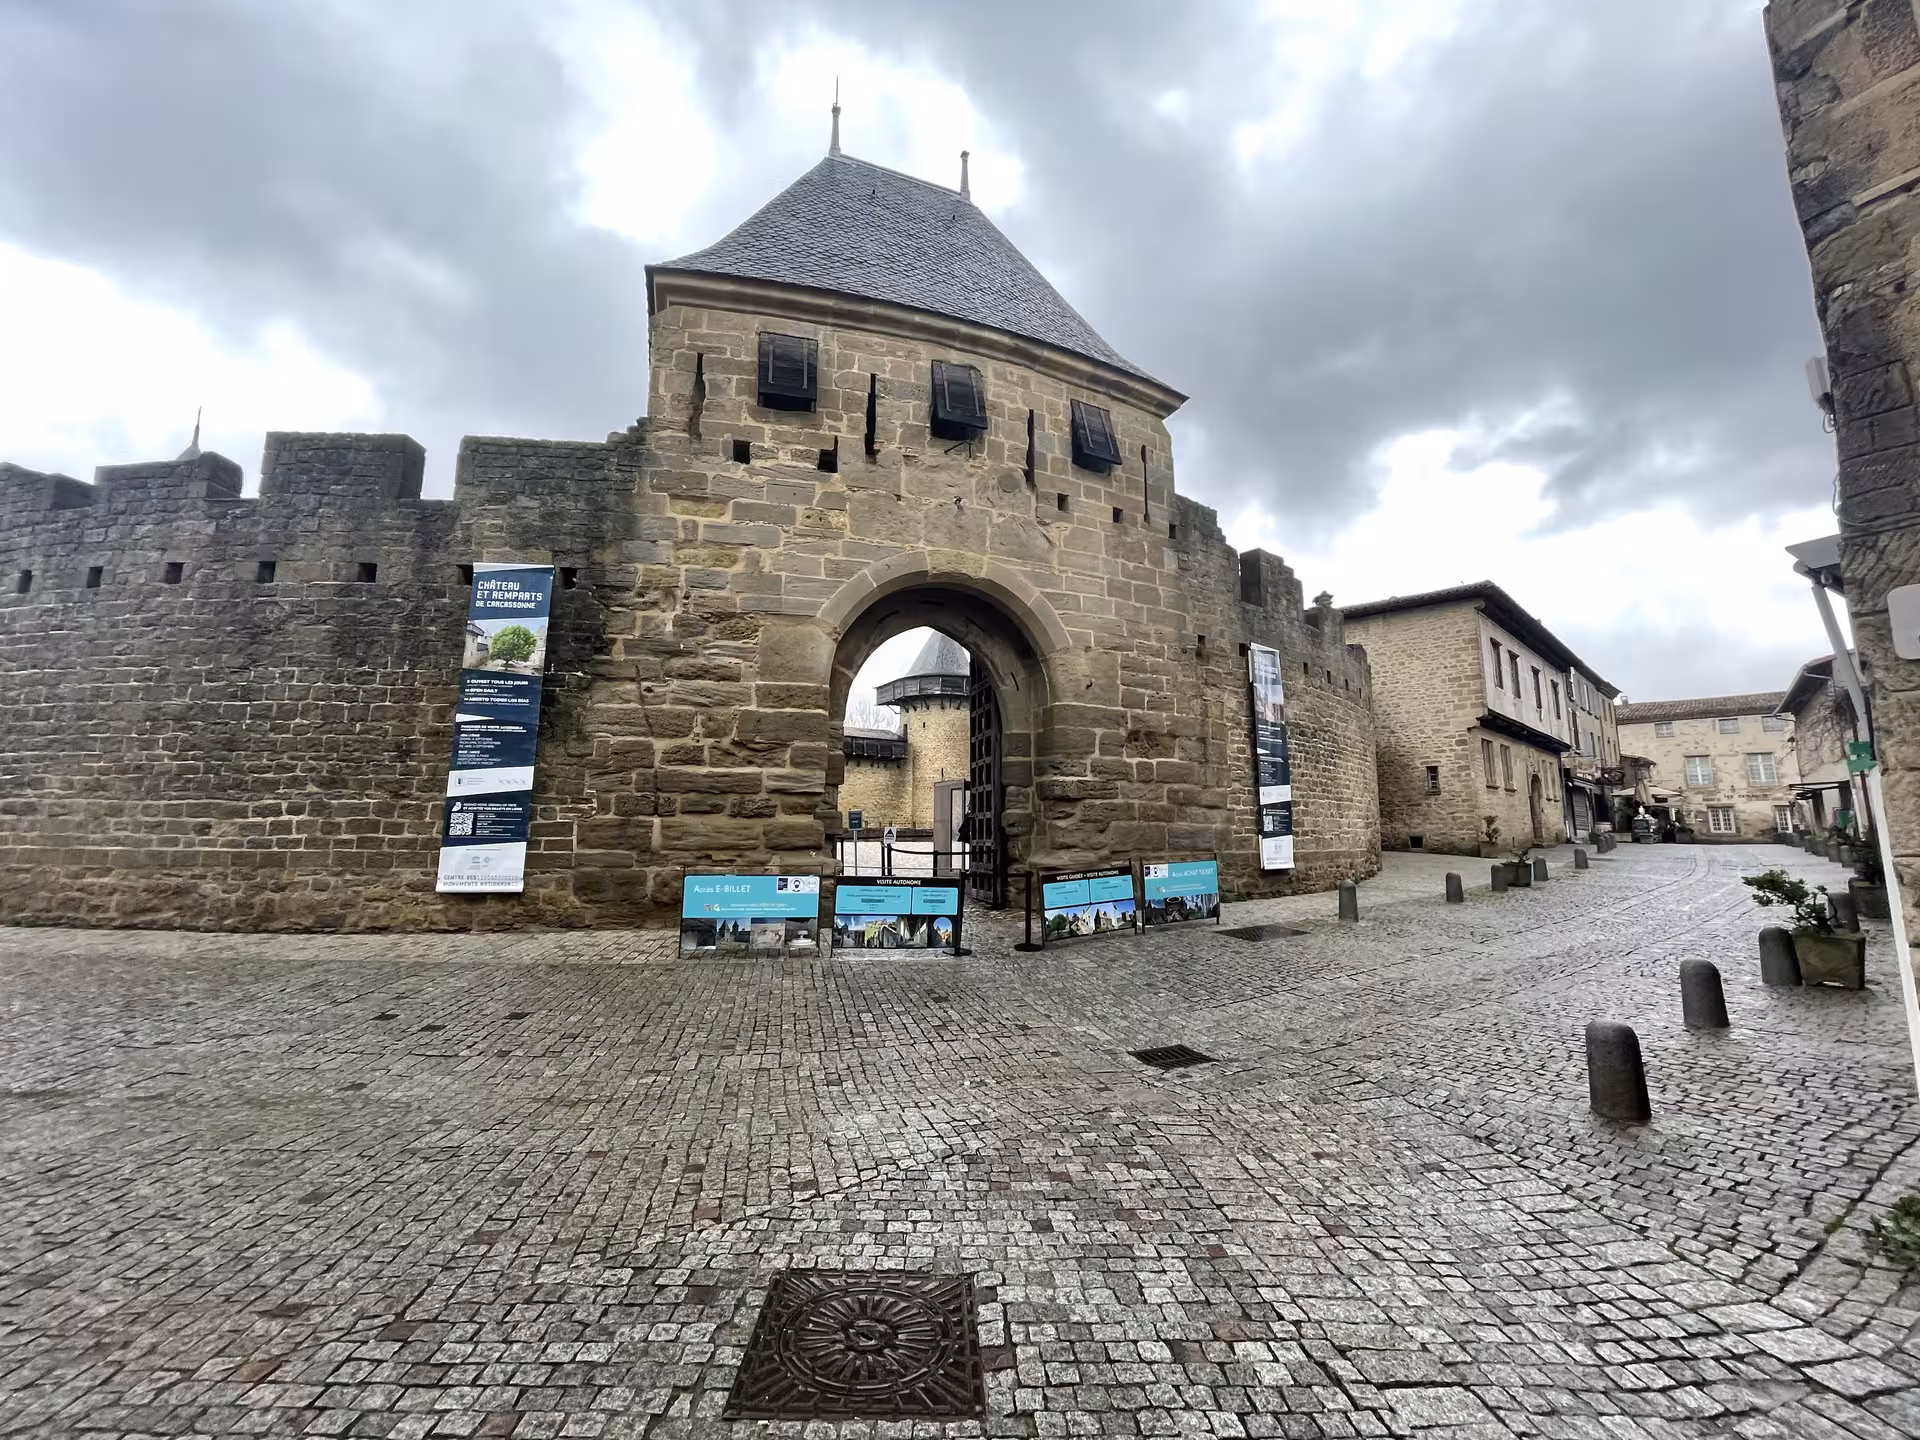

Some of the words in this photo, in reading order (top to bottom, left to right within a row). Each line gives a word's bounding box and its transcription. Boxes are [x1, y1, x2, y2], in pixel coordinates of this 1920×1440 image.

[478, 579, 520, 591] CHÂTEAU
[477, 590, 489, 599] ET
[492, 591, 543, 601] REMPARTS
[486, 601, 536, 609] CARCASSONNE
[693, 885, 714, 893] Accès
[715, 884, 751, 893] E-BILLET
